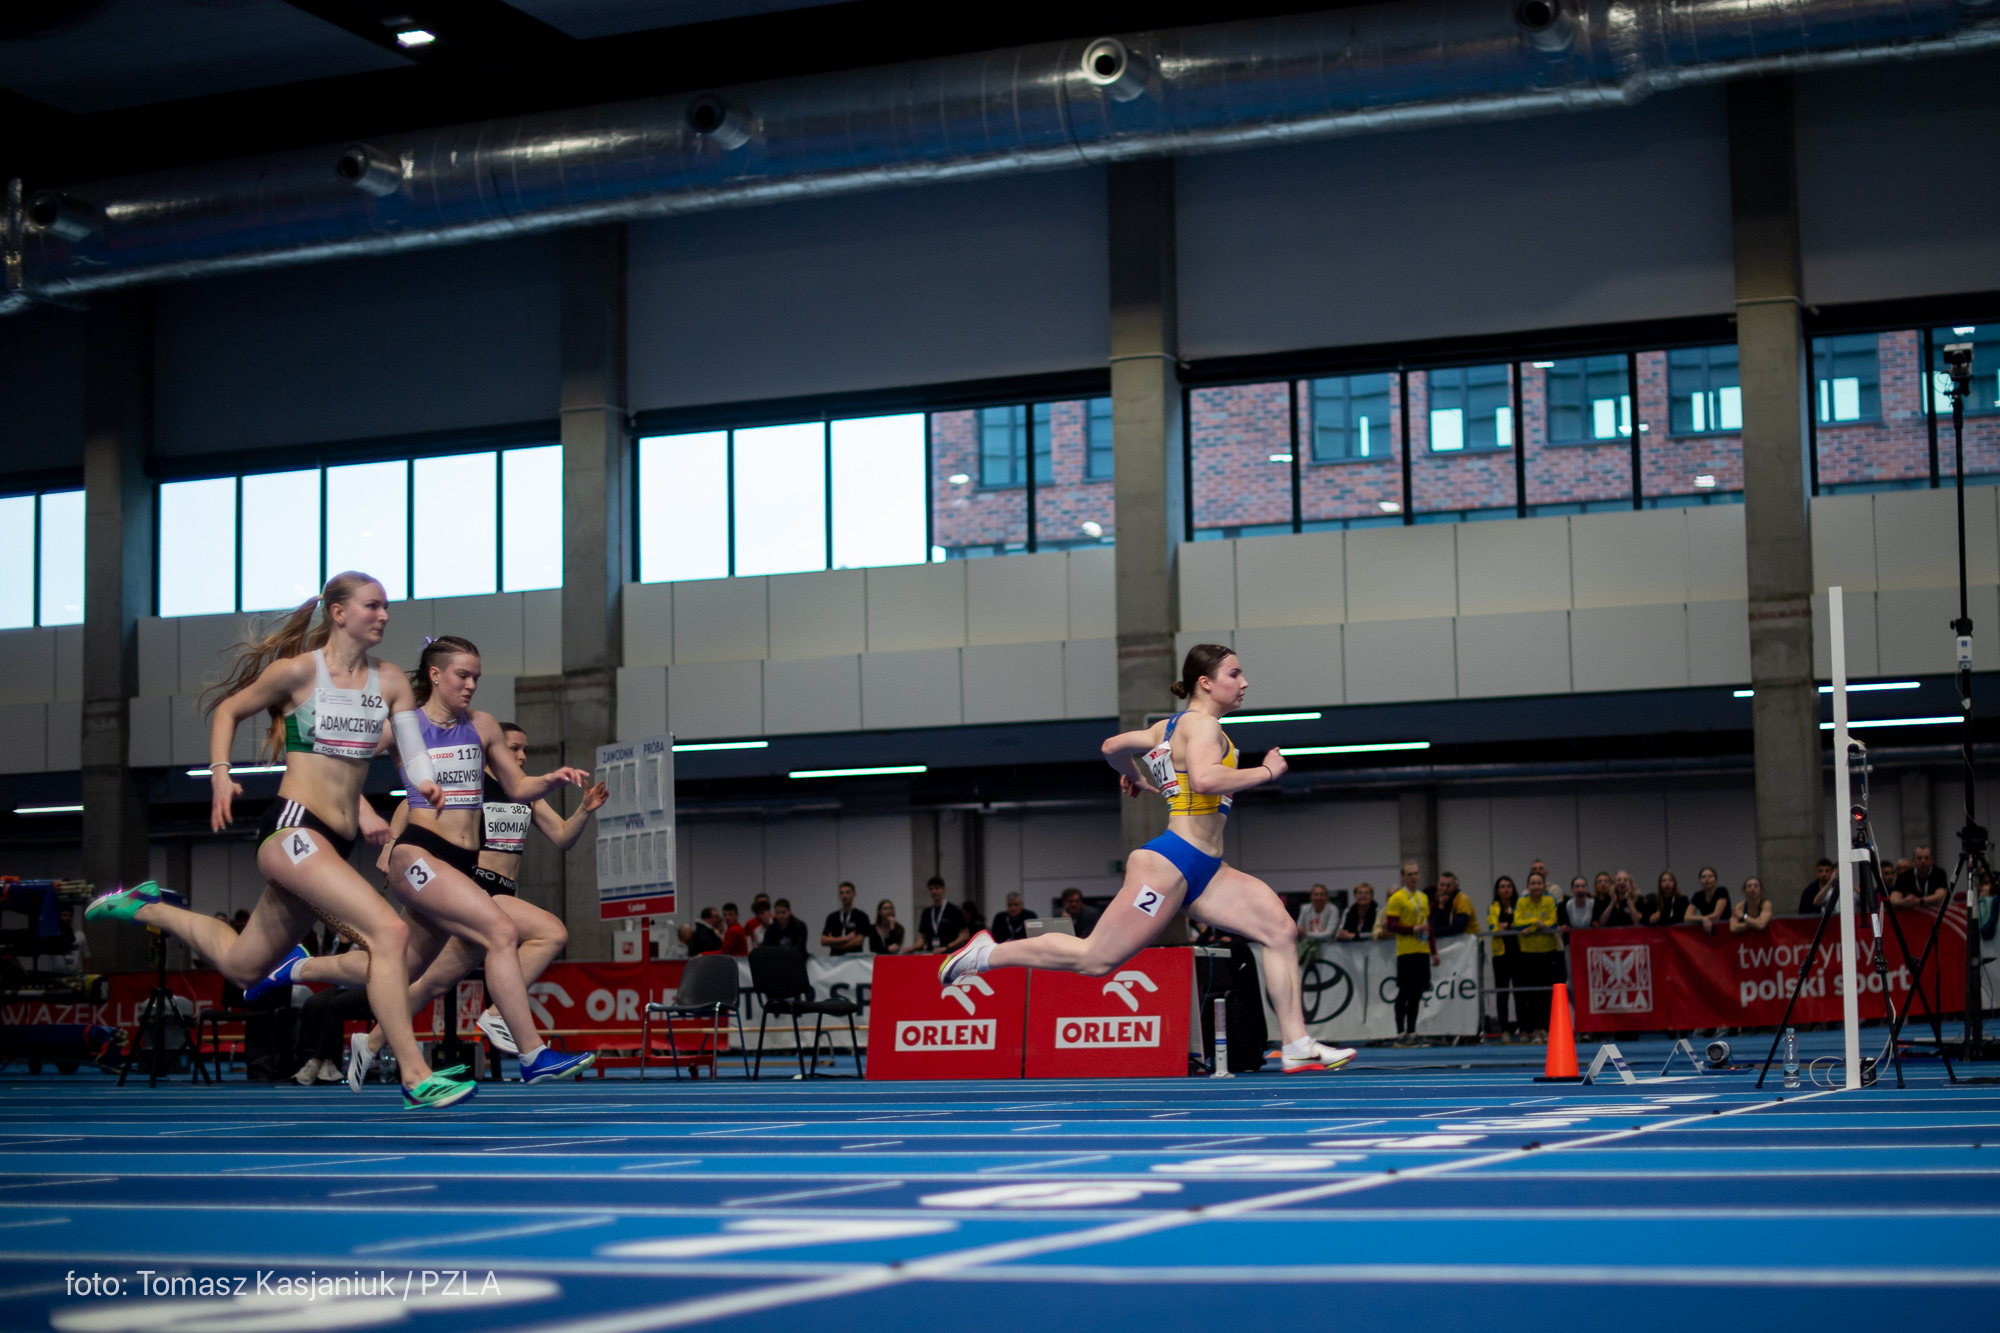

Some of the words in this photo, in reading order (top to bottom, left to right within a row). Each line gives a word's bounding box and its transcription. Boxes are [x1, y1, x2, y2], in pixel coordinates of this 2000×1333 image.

[361, 694, 383, 709] 262
[430, 752, 454, 760] ODZIO
[602, 746, 634, 764] ZAWODNIK
[643, 740, 665, 755] PRÓBA
[510, 805, 529, 815] 382
[293, 834, 311, 857] 4
[410, 865, 429, 885] 3
[475, 867, 497, 881] RO
[1138, 891, 1158, 913] 2
[1740, 967, 1826, 1008] polski
[1593, 989, 1649, 1010] PZLA
[902, 1025, 989, 1047] ORLEN
[1062, 1021, 1154, 1044] ORLEN
